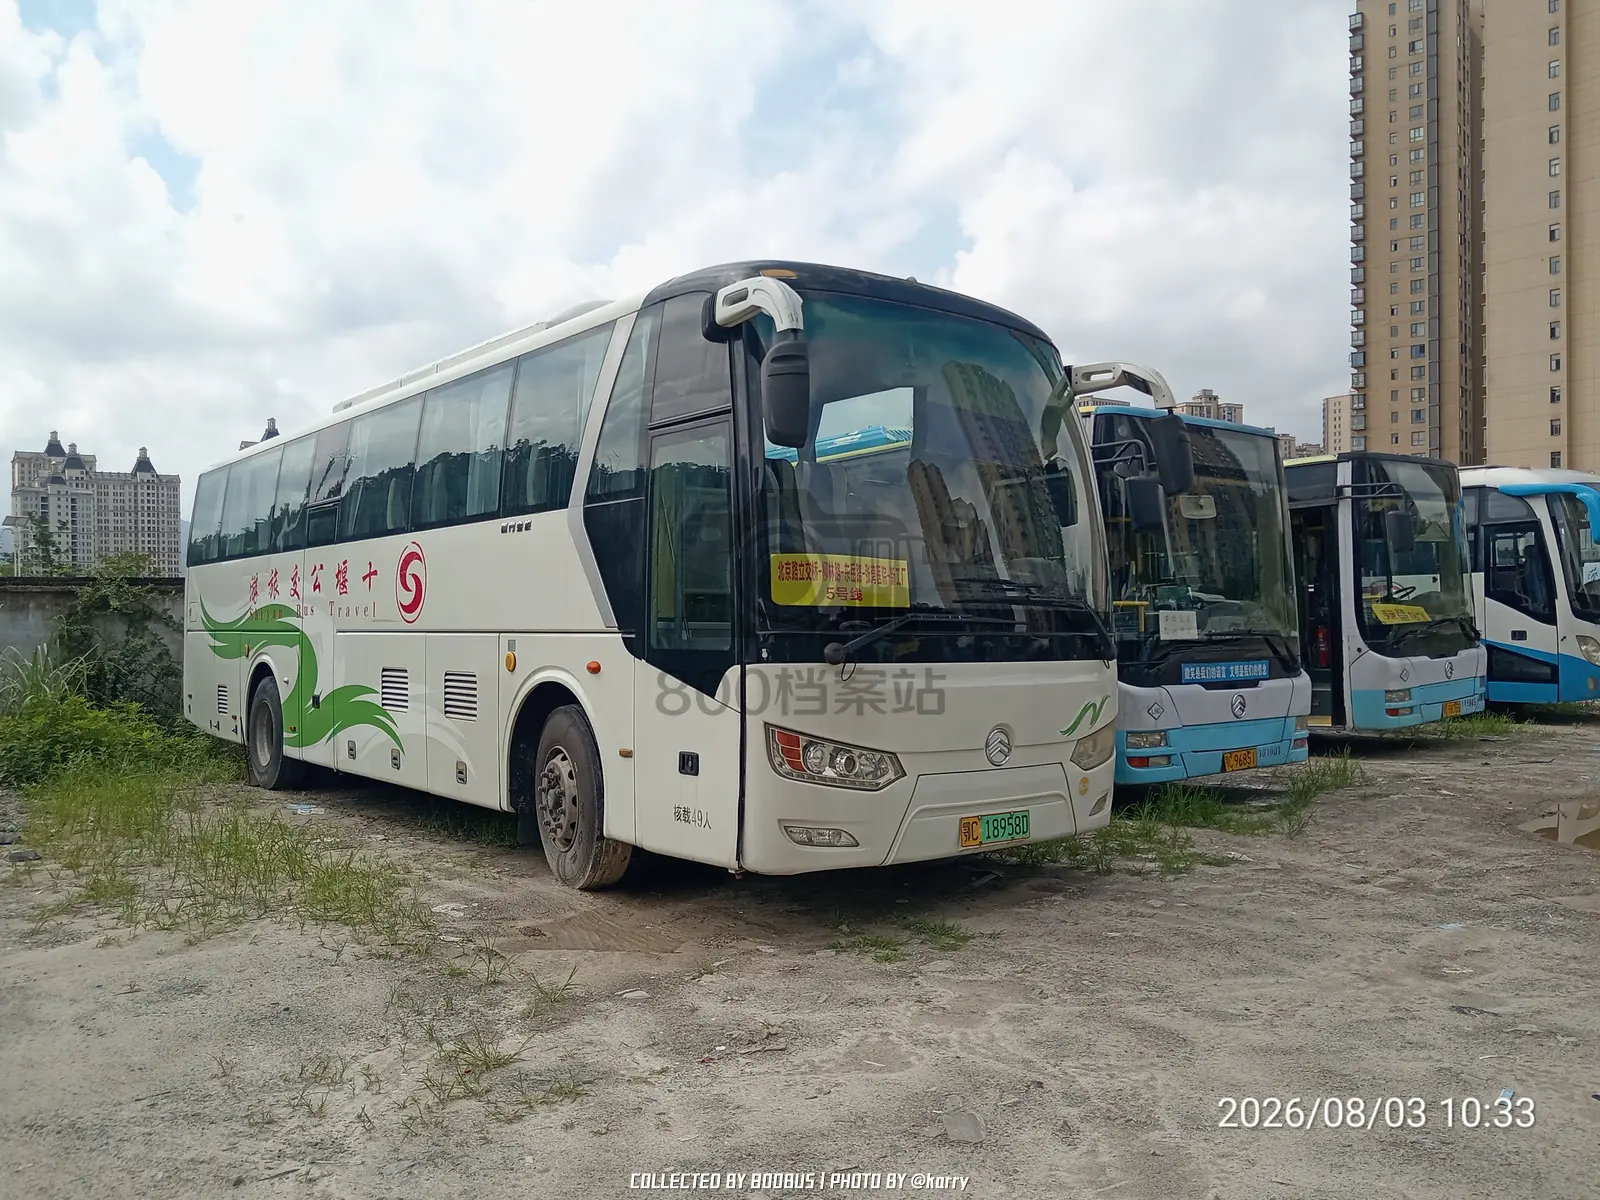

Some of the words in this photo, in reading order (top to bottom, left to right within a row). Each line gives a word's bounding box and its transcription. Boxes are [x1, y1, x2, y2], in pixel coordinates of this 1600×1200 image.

[826, 586, 863, 602] 5号线
[296, 603, 315, 619] Bus
[329, 600, 376, 618] Travel
[673, 803, 712, 830] 核载49人
